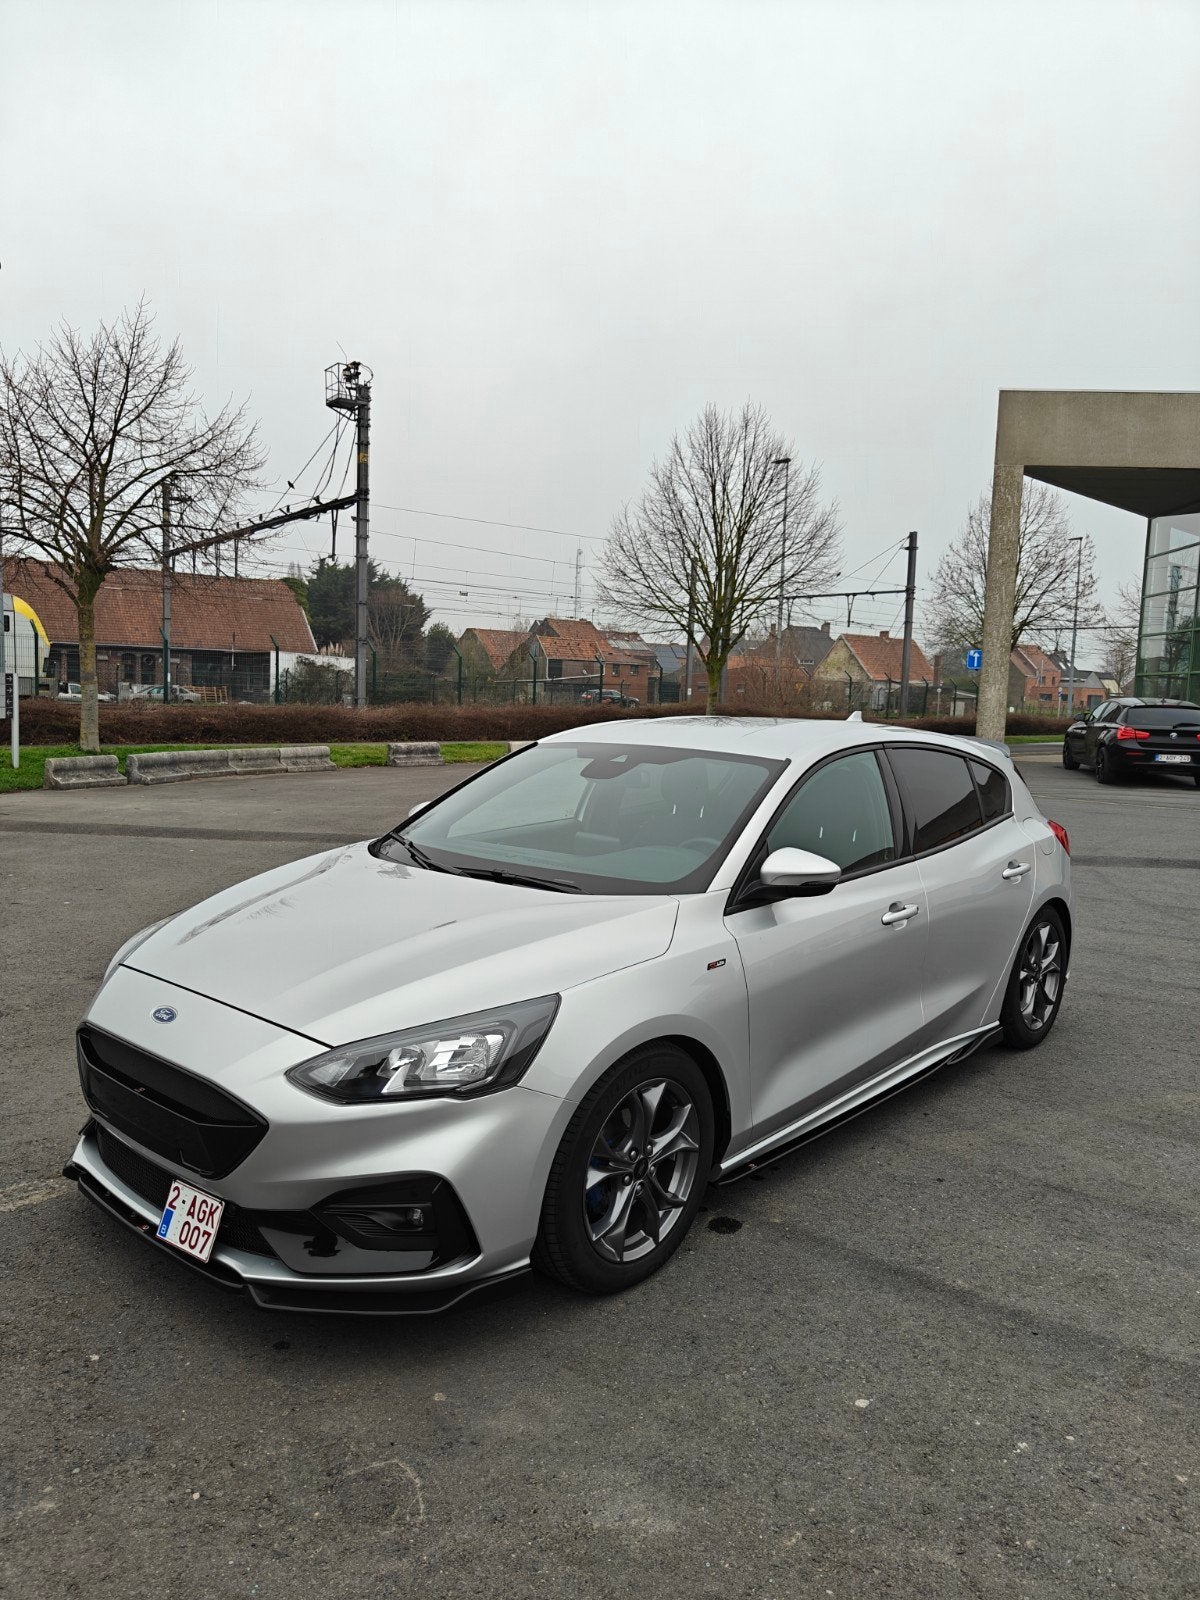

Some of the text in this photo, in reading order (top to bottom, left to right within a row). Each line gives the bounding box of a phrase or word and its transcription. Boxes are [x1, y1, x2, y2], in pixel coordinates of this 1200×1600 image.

[156, 1008, 172, 1021] Ford
[160, 1224, 167, 1234] B
[179, 1220, 212, 1254] 007
